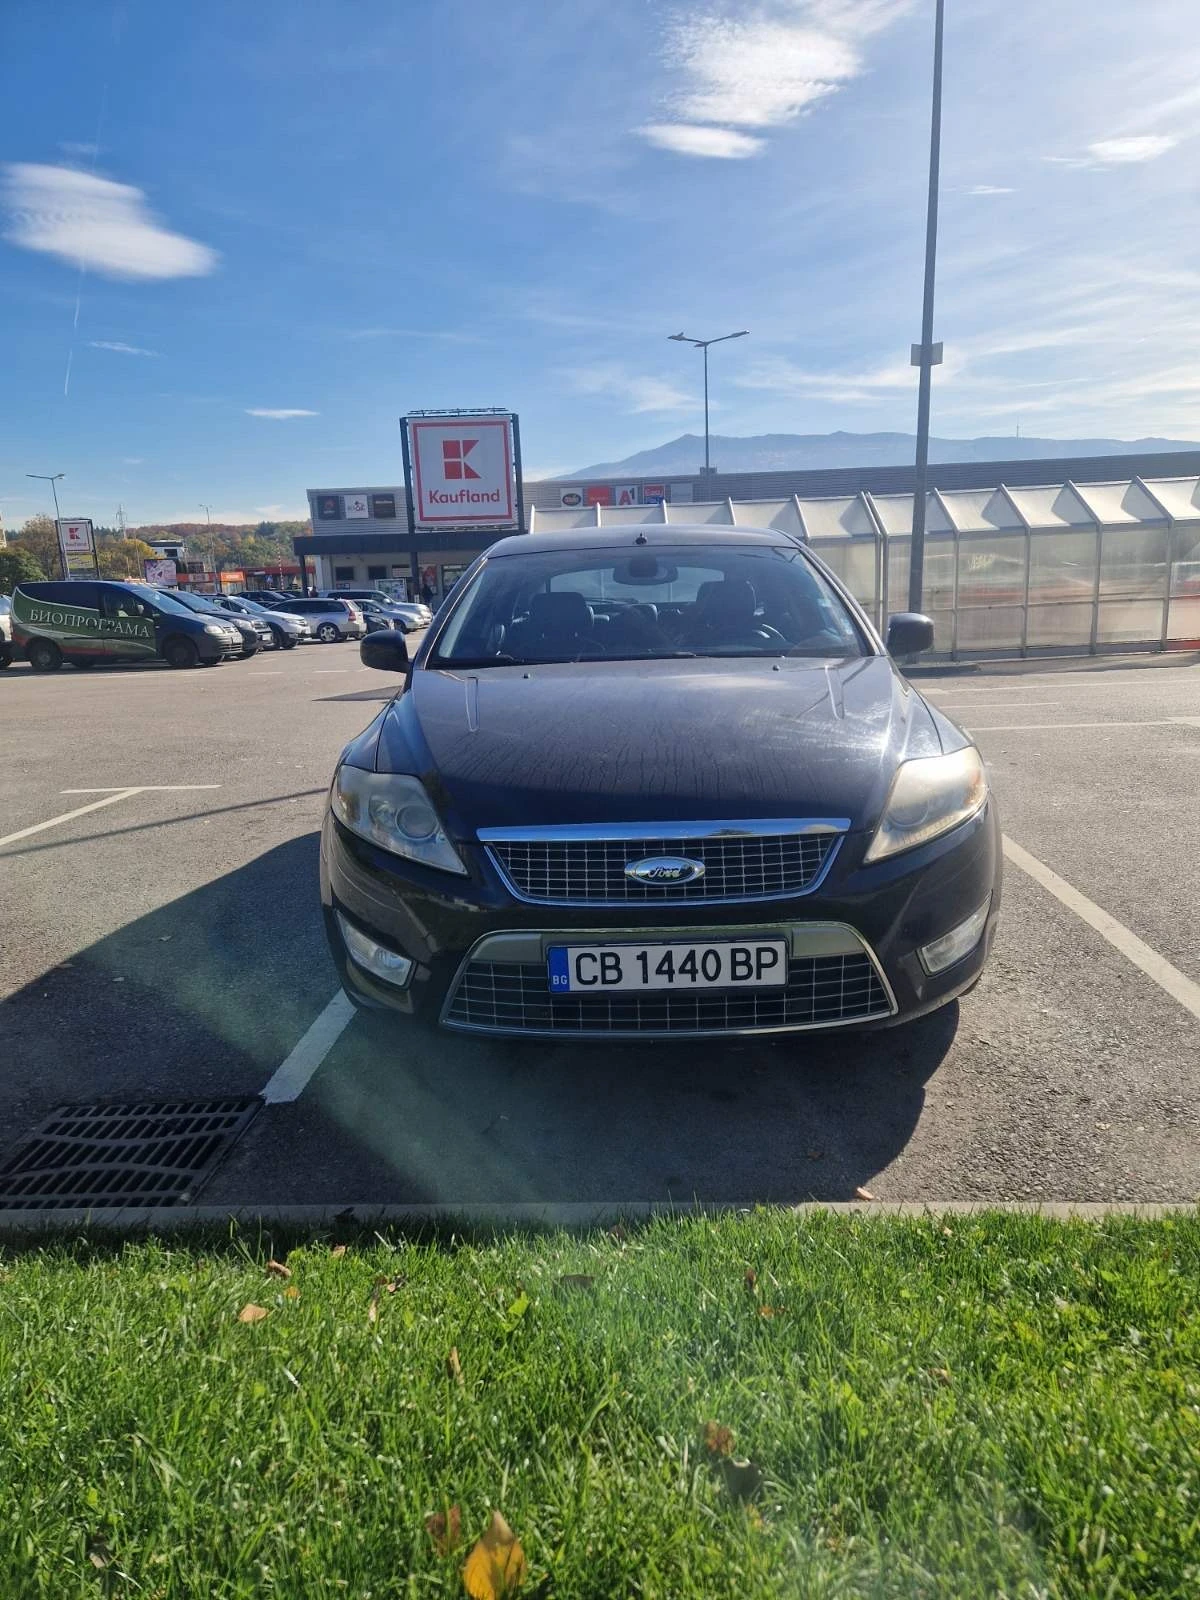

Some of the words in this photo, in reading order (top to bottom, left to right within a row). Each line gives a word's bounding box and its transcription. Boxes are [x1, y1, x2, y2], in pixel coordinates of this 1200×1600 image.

[429, 489, 500, 504] Kaufland
[619, 487, 635, 505] A1
[30, 609, 150, 637] БИОПРОГРАМА
[575, 951, 623, 986] CB
[636, 948, 722, 984] 1440
[730, 947, 778, 981] BP
[553, 975, 568, 985] BG
